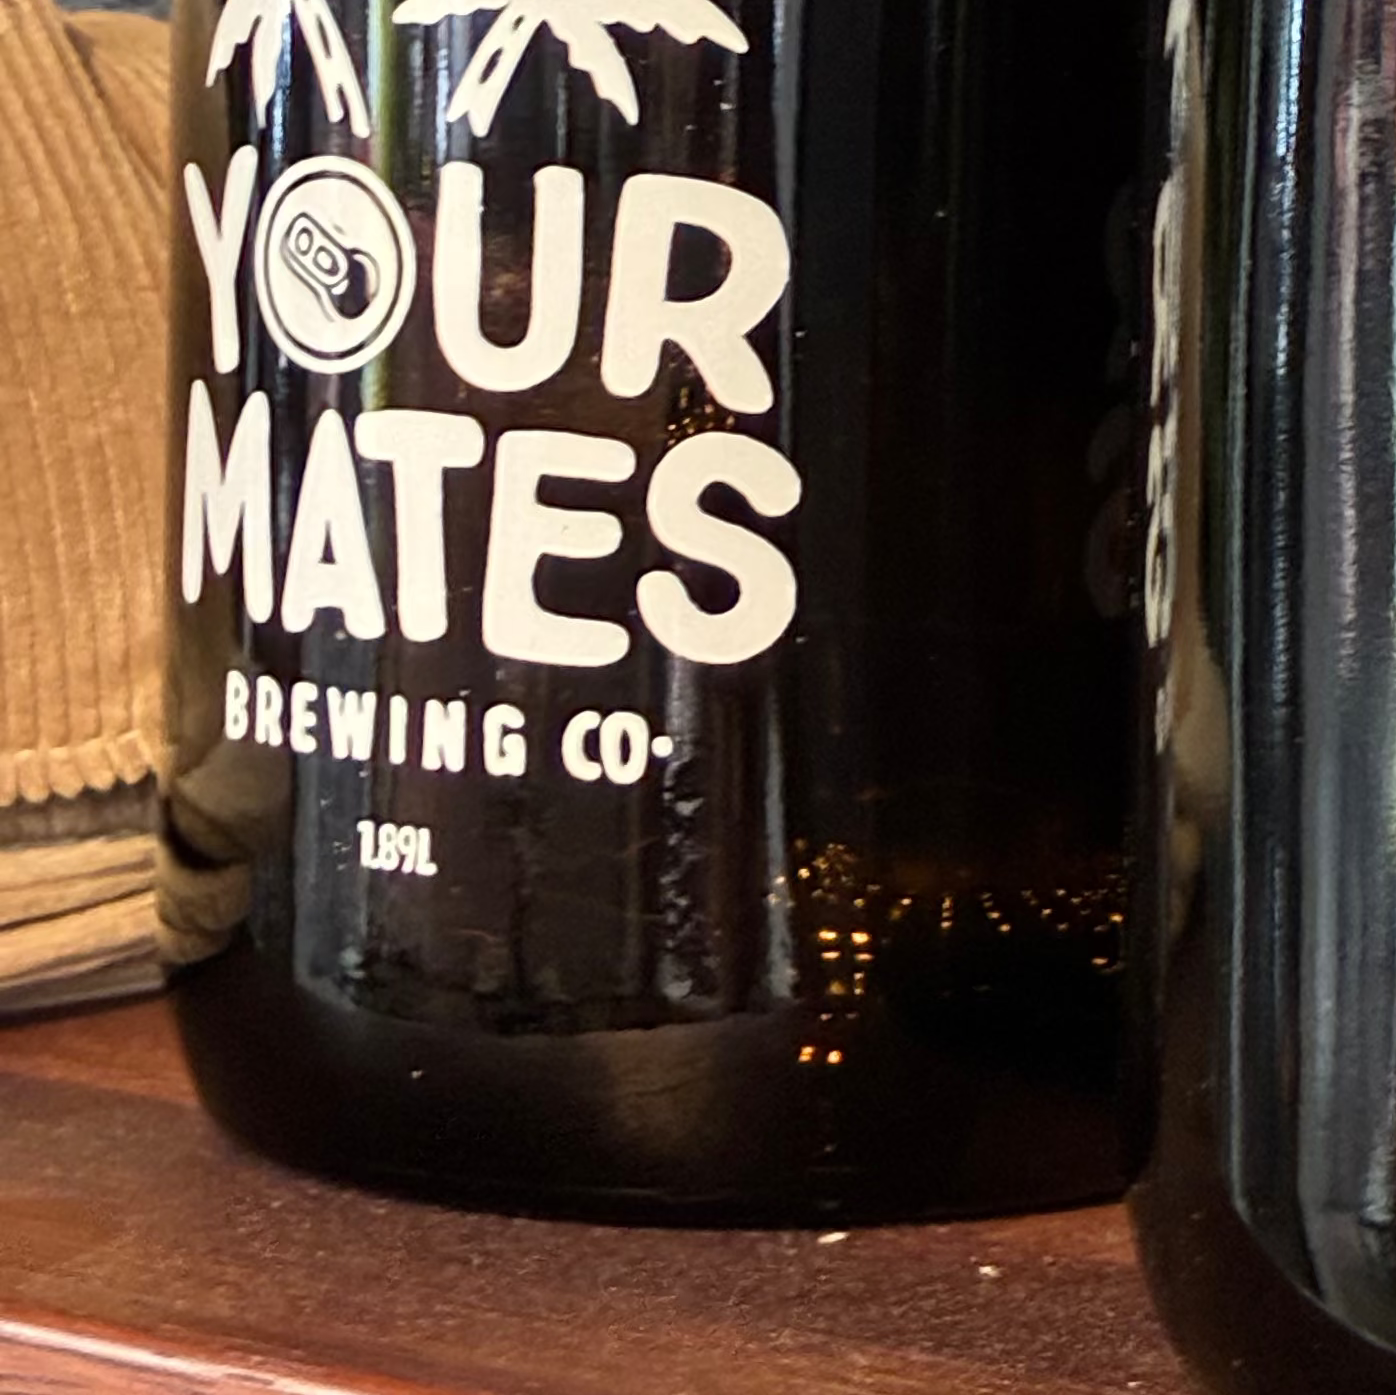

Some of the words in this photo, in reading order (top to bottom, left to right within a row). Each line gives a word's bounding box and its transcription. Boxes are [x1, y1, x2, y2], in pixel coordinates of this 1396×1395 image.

[183, 145, 790, 415] YOUR
[182, 379, 802, 667] MATES
[225, 670, 526, 777] BREWING
